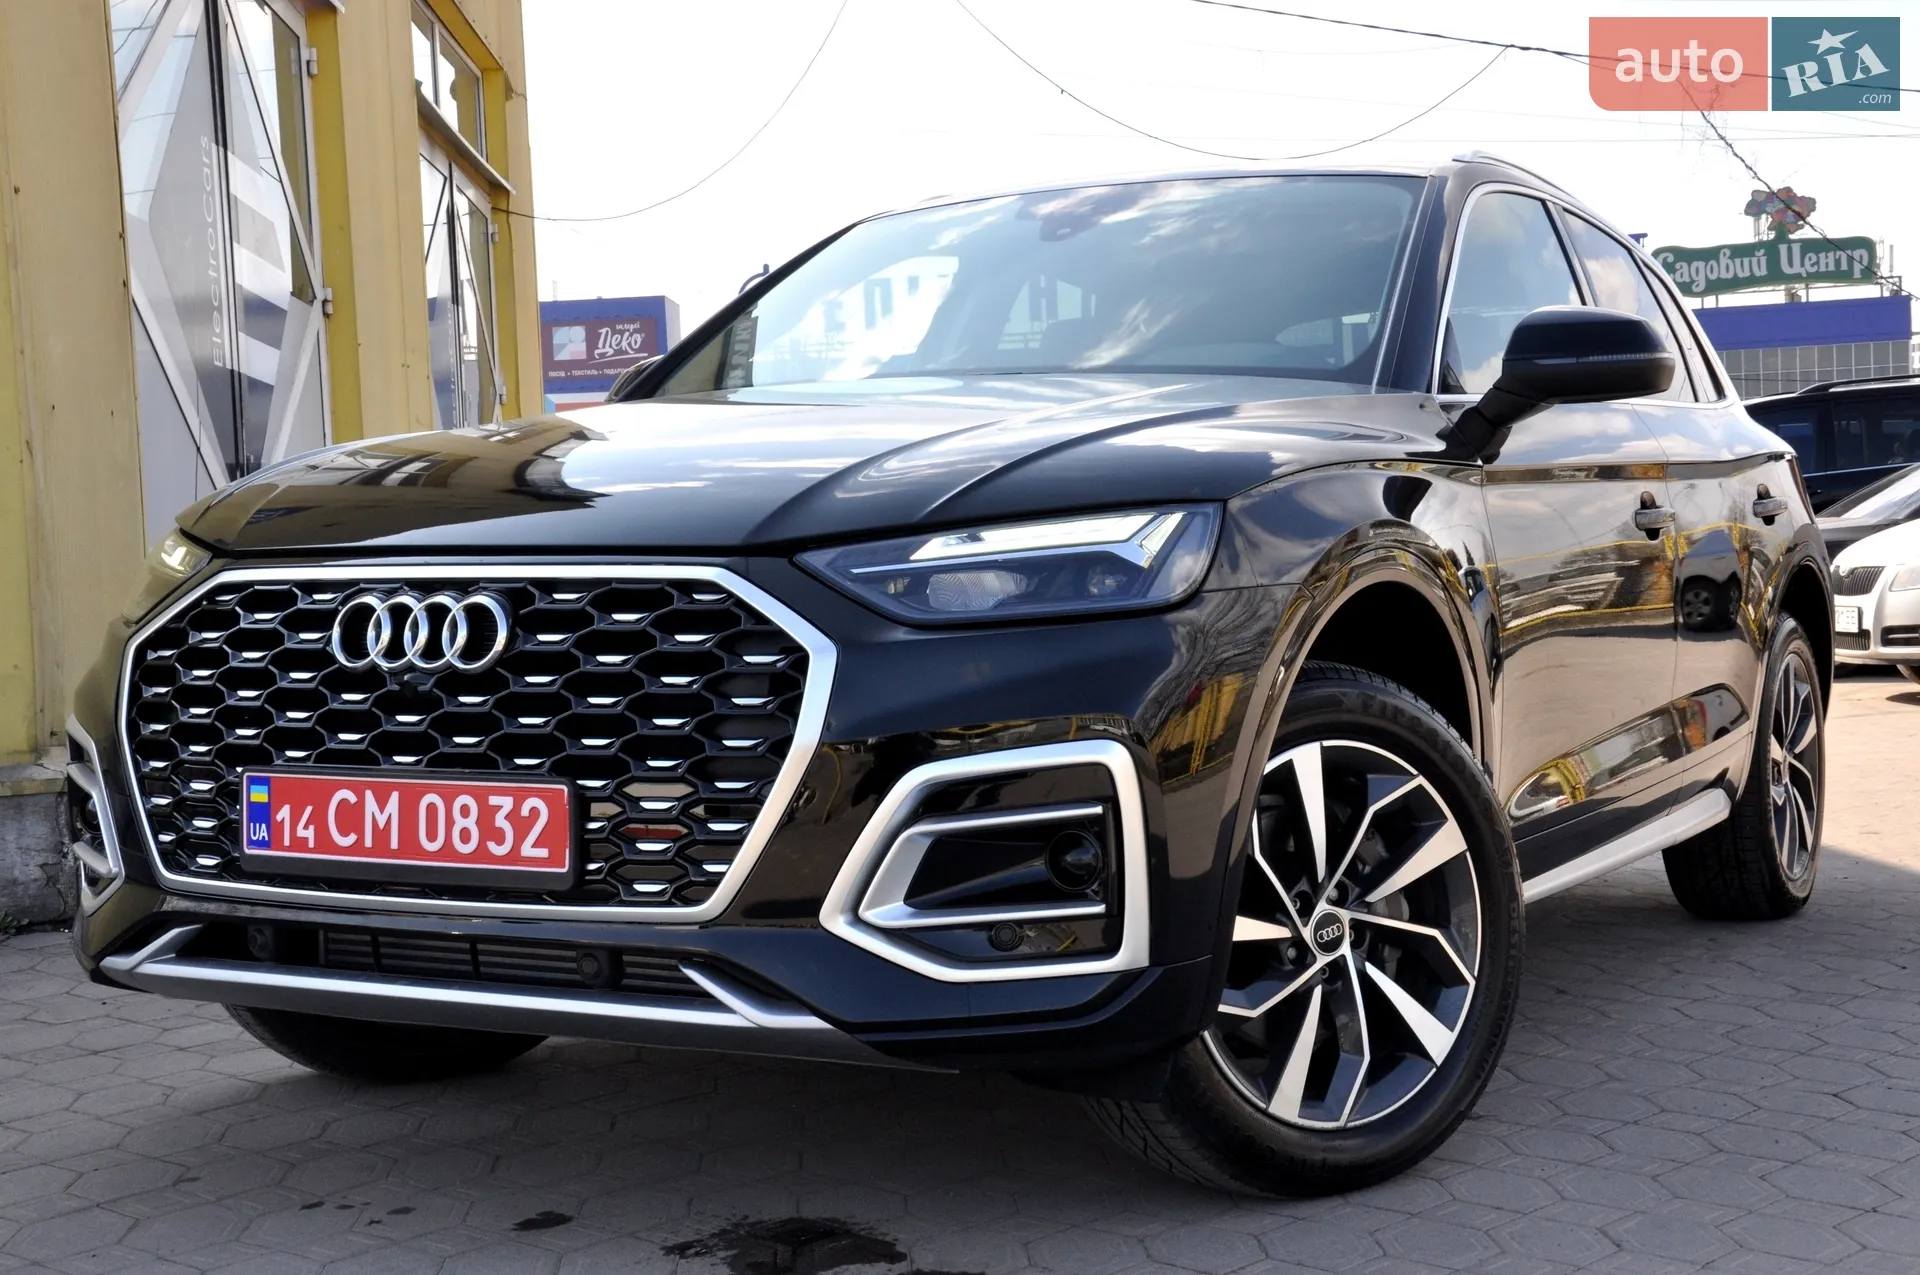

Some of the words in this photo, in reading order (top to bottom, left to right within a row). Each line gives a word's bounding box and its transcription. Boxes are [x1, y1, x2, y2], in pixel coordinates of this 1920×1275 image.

[200, 134, 224, 368] ElectroCars
[1656, 247, 1768, 293] Садовий
[1778, 243, 1869, 279] Центр
[594, 327, 643, 359] Деко
[250, 822, 268, 842] UA
[275, 804, 315, 848] 14
[327, 788, 401, 850] CM
[418, 793, 549, 859] 0832
